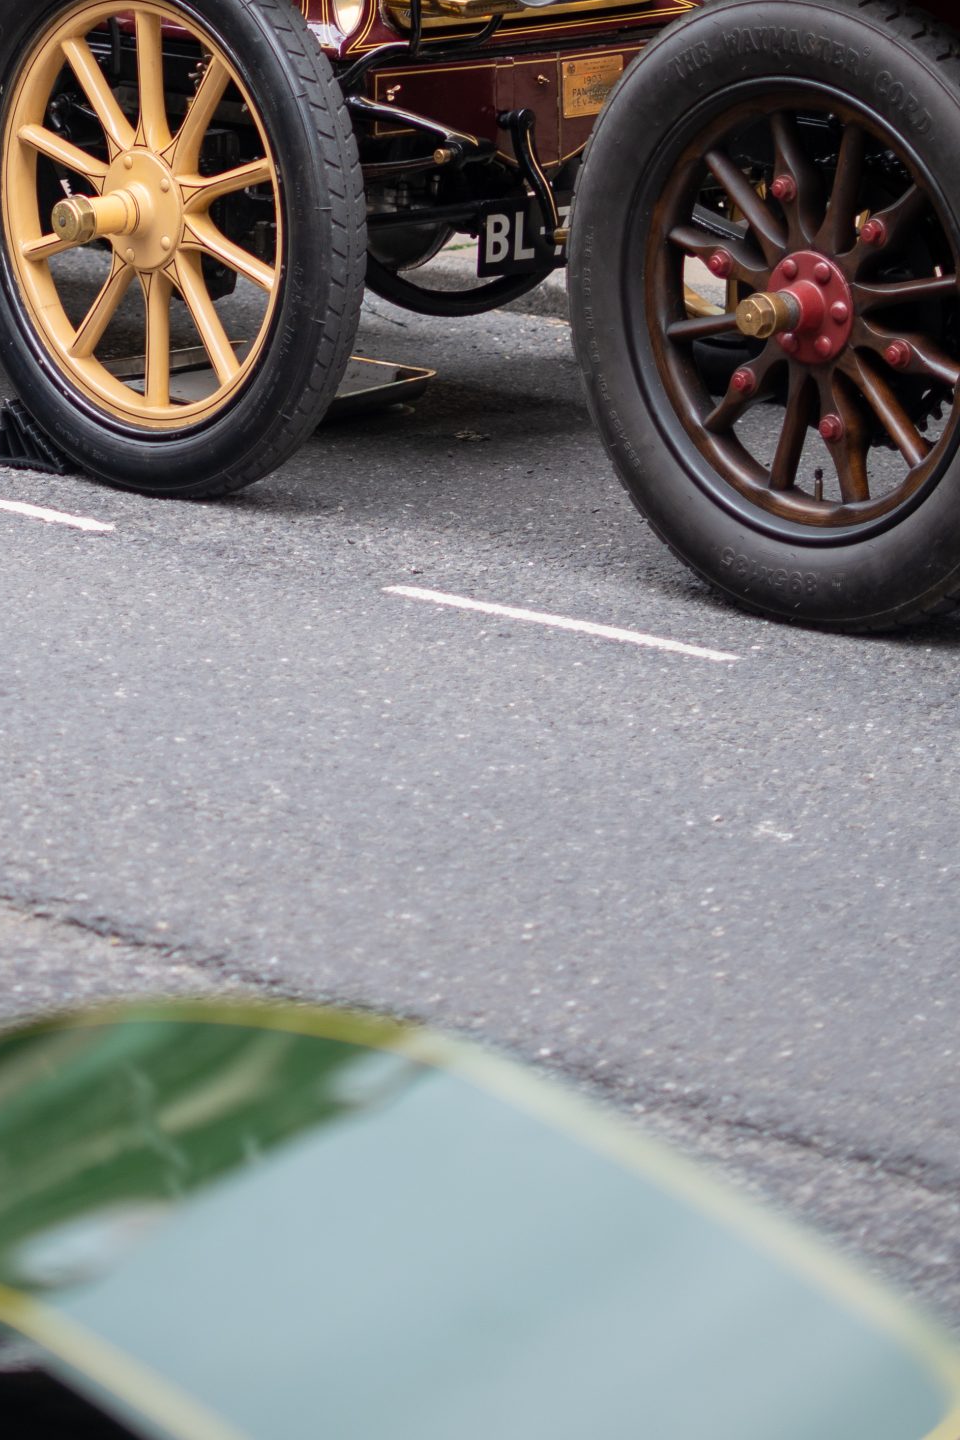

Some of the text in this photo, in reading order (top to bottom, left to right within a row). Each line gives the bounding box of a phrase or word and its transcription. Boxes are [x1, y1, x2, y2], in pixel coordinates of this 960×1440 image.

[667, 40, 713, 80] THE
[873, 70, 933, 136] CORD
[485, 211, 535, 264] BL
